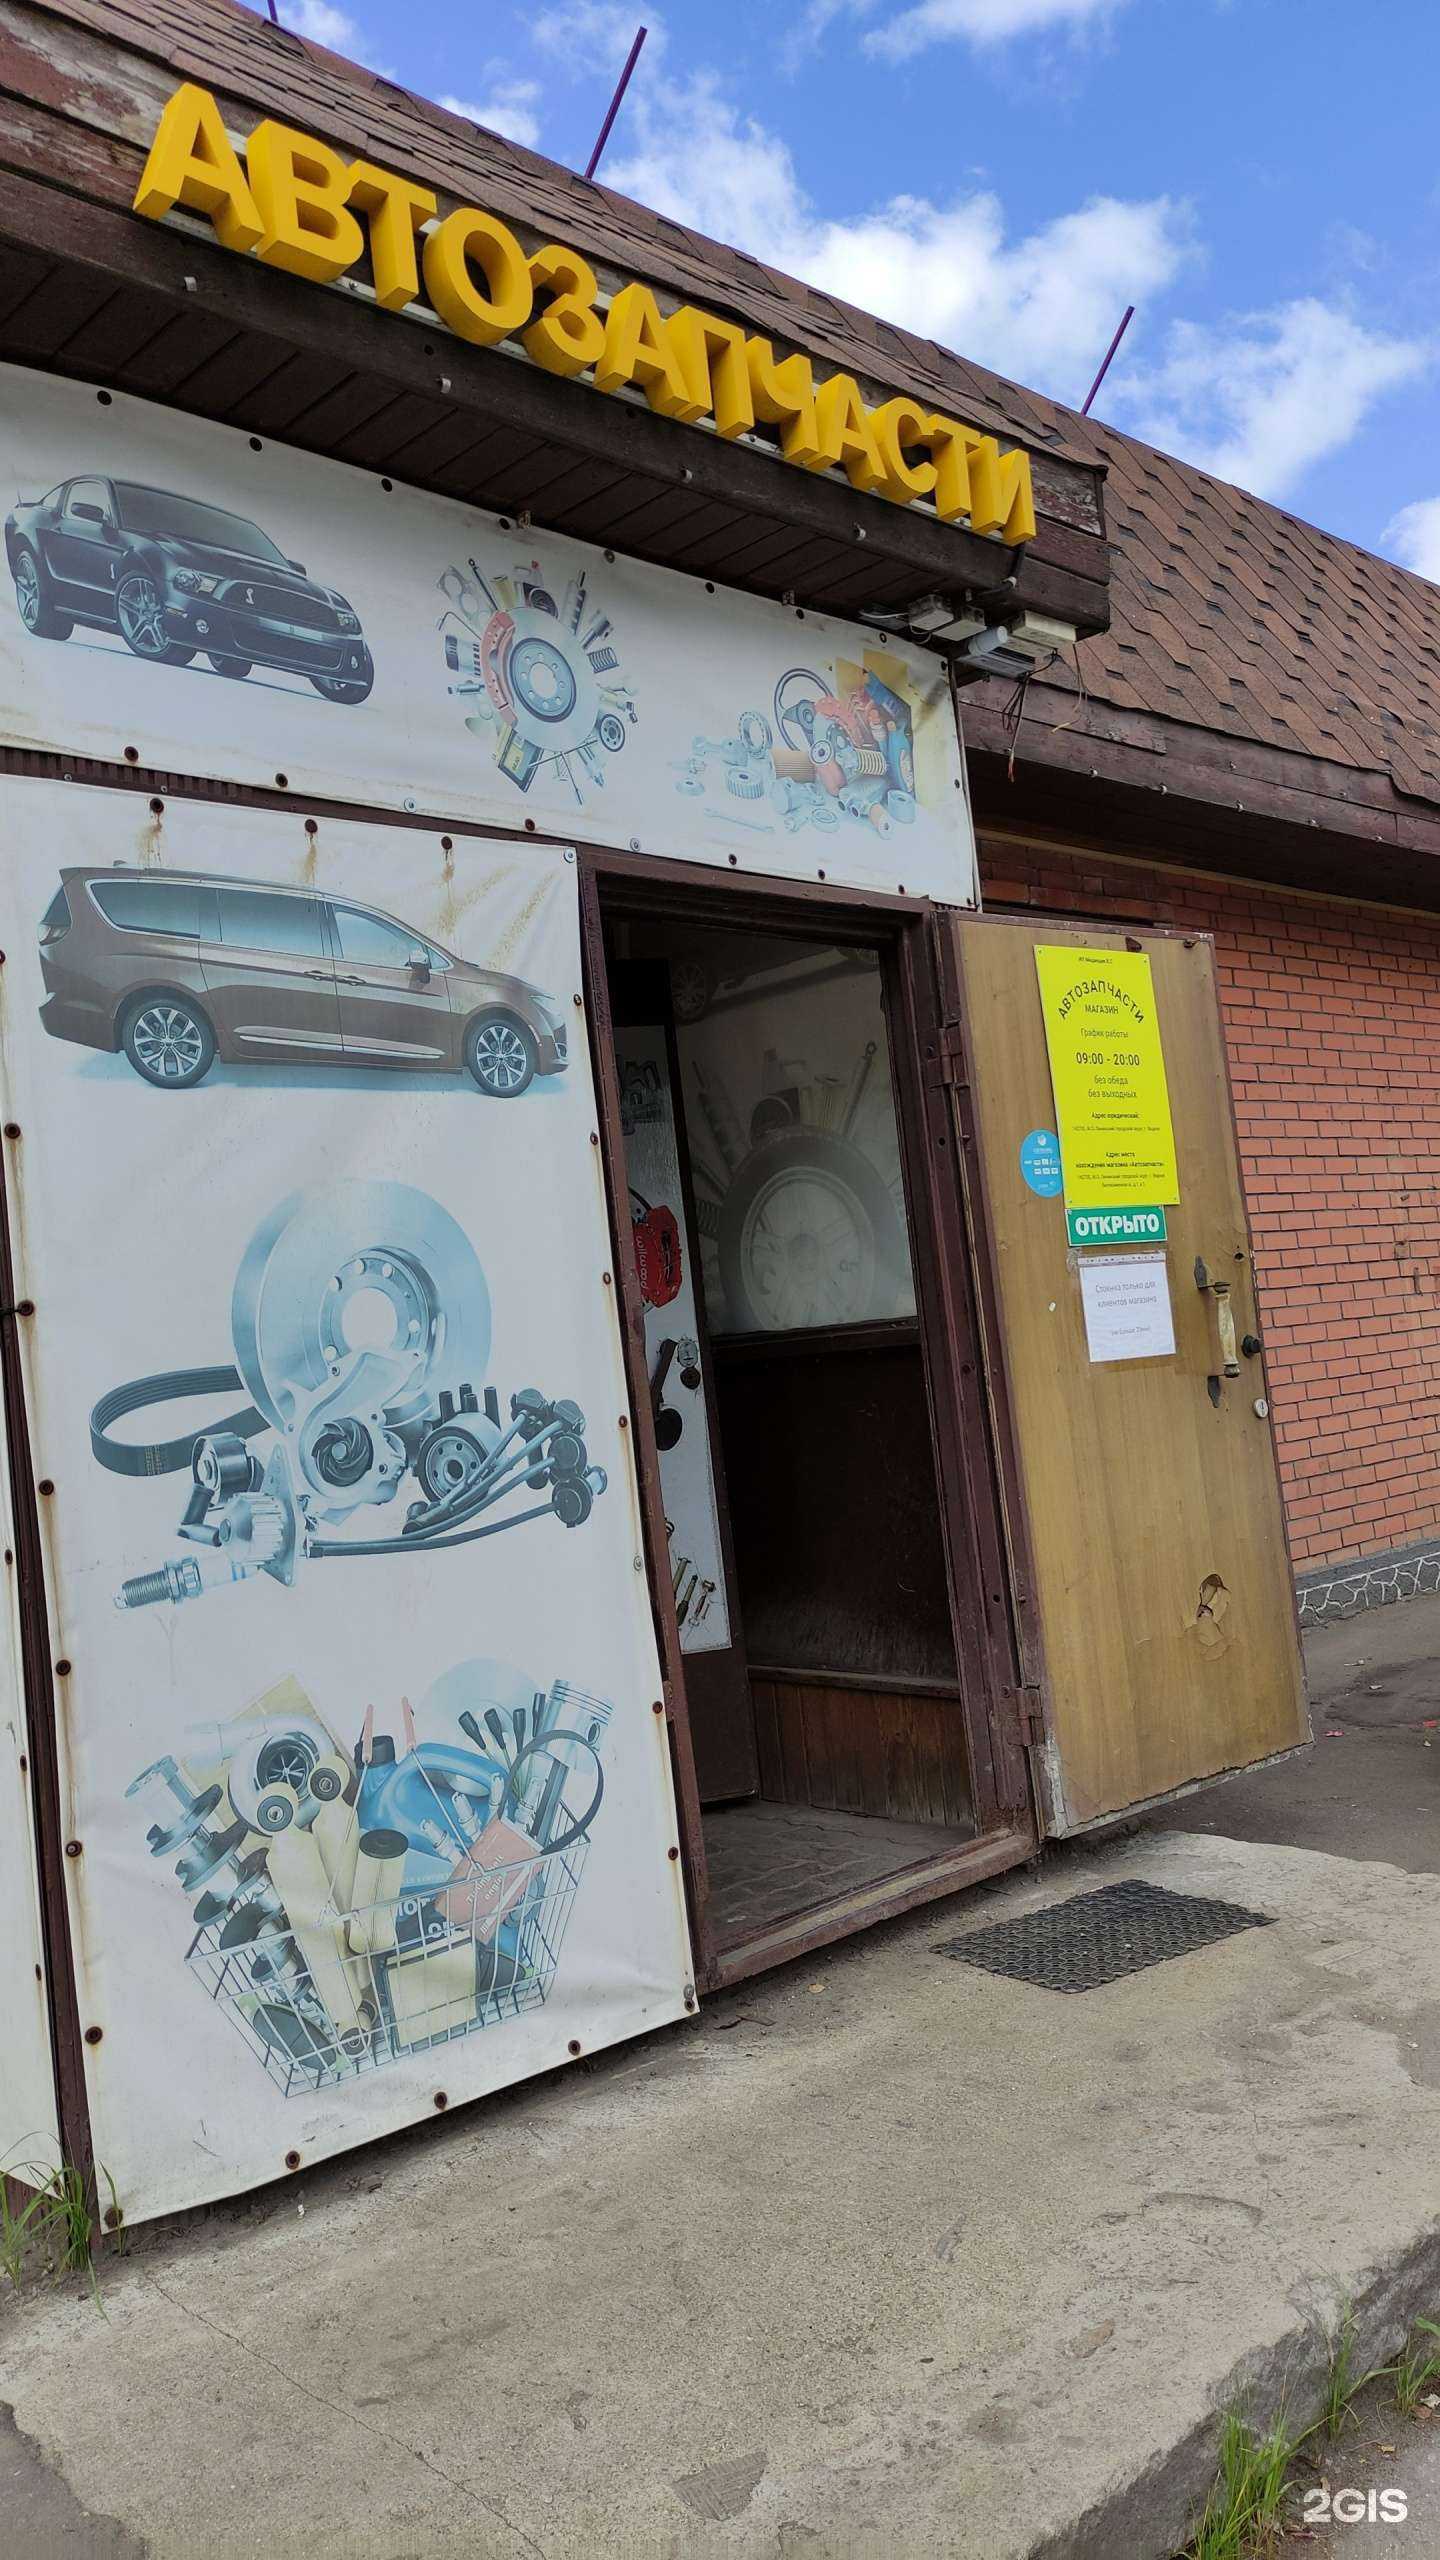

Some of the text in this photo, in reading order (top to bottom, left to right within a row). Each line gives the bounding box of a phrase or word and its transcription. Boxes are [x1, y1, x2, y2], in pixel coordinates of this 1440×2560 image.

[134, 82, 1036, 546] АВТОЗАПЧАСТИ
[1058, 980, 1144, 1023] АВТОЗАПЧАСТИ
[1085, 1004, 1119, 1014] МАГАЗИН
[1105, 1030, 1129, 1039] работы
[1076, 1052, 1103, 1064] 09:00
[1113, 1053, 1140, 1065] 20:00
[1094, 1075, 1128, 1085] без обеда
[1088, 1089, 1137, 1099] без выходных
[1075, 1213, 1160, 1237] ОТКРЫТО
